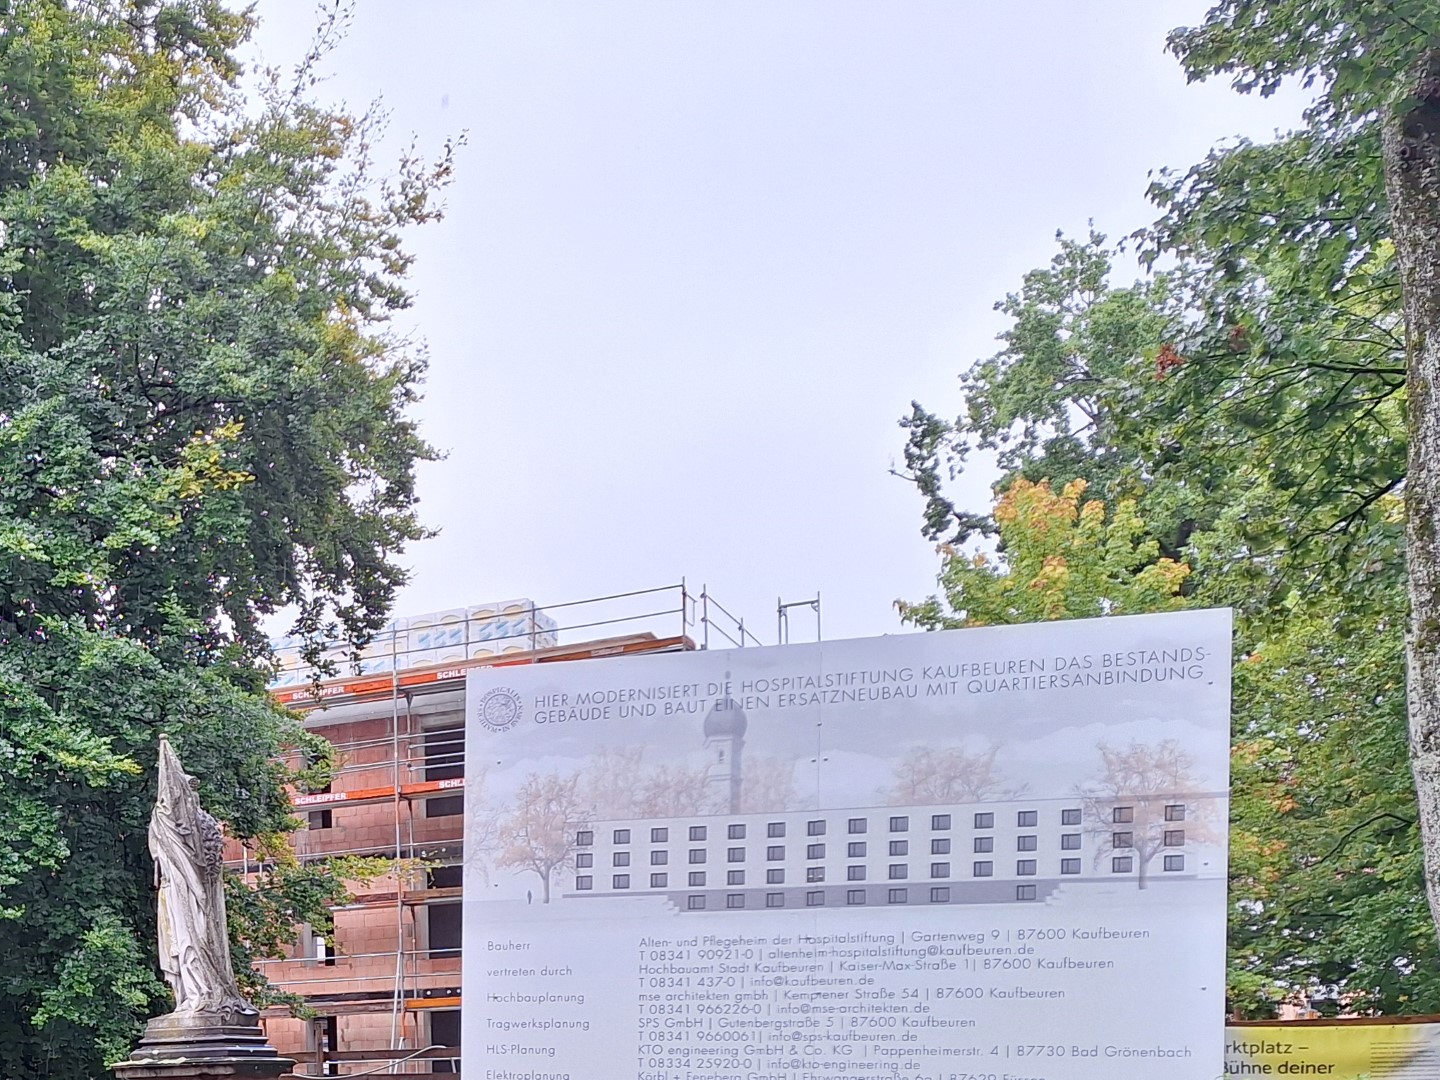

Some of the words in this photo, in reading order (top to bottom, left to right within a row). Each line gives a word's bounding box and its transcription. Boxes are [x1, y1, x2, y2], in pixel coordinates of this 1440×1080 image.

[534, 693, 569, 709] HIER
[575, 683, 700, 706] MODERNISIERT
[706, 681, 732, 697] DIE
[741, 668, 914, 694] HOSPITALSTIFTUNG
[922, 658, 1045, 682] KAUFBEUREN
[1054, 654, 1093, 672] DAS
[1102, 646, 1212, 669] BESTANDS-
[533, 702, 611, 724] GEBÄUDE
[618, 702, 656, 718] UND
[664, 698, 707, 715] BAUT
[714, 694, 770, 712] EINEN
[778, 684, 918, 708] ERSATZNEUBAU
[926, 681, 958, 698] MIT
[966, 664, 1204, 695] QUARTIERSANBINDUNG
[294, 792, 347, 805] SCHLEIPFER
[487, 938, 530, 950] Bauherr
[638, 935, 672, 947] Alten-
[676, 935, 698, 947] und
[702, 933, 768, 949] Pflegeheim
[772, 933, 792, 945] der
[797, 931, 895, 947] Hospitalstiftung
[910, 930, 985, 945] Gartenweg
[990, 930, 1000, 941] 9
[1017, 928, 1066, 940] 87600
[1072, 925, 1150, 939] Kaufbeuren
[638, 950, 646, 961] T
[649, 950, 690, 961] 08341
[697, 949, 754, 960] 90921-0
[486, 966, 536, 976] vertreten
[540, 964, 572, 976] durch
[638, 962, 714, 974] Hochbauamt
[718, 961, 750, 973] Stadt
[754, 960, 824, 973] Kaufbeuren
[839, 958, 957, 972] Kaiser-Max-Straße
[983, 958, 1032, 970] 87600
[1037, 955, 1114, 969] Kaufbeuren
[638, 977, 645, 988] T
[649, 977, 690, 987] 08341
[696, 976, 736, 987] 437-0
[486, 990, 584, 1005] Hochbauplanung
[665, 989, 730, 1001] architekten
[734, 988, 769, 1003] gmbh
[783, 989, 849, 1003] Kemptener
[854, 987, 896, 999] Straße
[900, 988, 919, 999] 54
[936, 988, 984, 999] 87600
[989, 985, 1065, 998] Kaufbeuren
[637, 1004, 645, 1014] T
[648, 1004, 690, 1014] 08341
[696, 1003, 762, 1014] 966226-0
[485, 1016, 590, 1031] Tragwerksplanung
[638, 1017, 660, 1028] SPS
[664, 1016, 703, 1028] GmbH
[717, 1015, 820, 1030] Gutenbergstraße
[825, 1017, 834, 1027] 5
[850, 1016, 897, 1027] 87600
[902, 1015, 976, 1027] Kaufbeuren
[637, 1031, 644, 1041] T
[648, 1031, 689, 1041] 08341
[486, 1043, 555, 1057] HLS-Planung
[637, 1044, 663, 1054] KTO
[667, 1044, 739, 1058] engineering
[743, 1043, 784, 1055] GmbH
[803, 1044, 826, 1055] Co.
[832, 1044, 853, 1055] KG
[873, 1043, 984, 1058] Pappenheimerstr.
[989, 1045, 999, 1056] 4
[1016, 1045, 1066, 1056] 87730
[1071, 1044, 1098, 1056] Bad
[1104, 1044, 1192, 1056] Grönenbach
[637, 1057, 644, 1068] T
[648, 1058, 691, 1068] 08334
[696, 1058, 752, 1068] 25920-0
[1278, 1061, 1335, 1074] deiner
